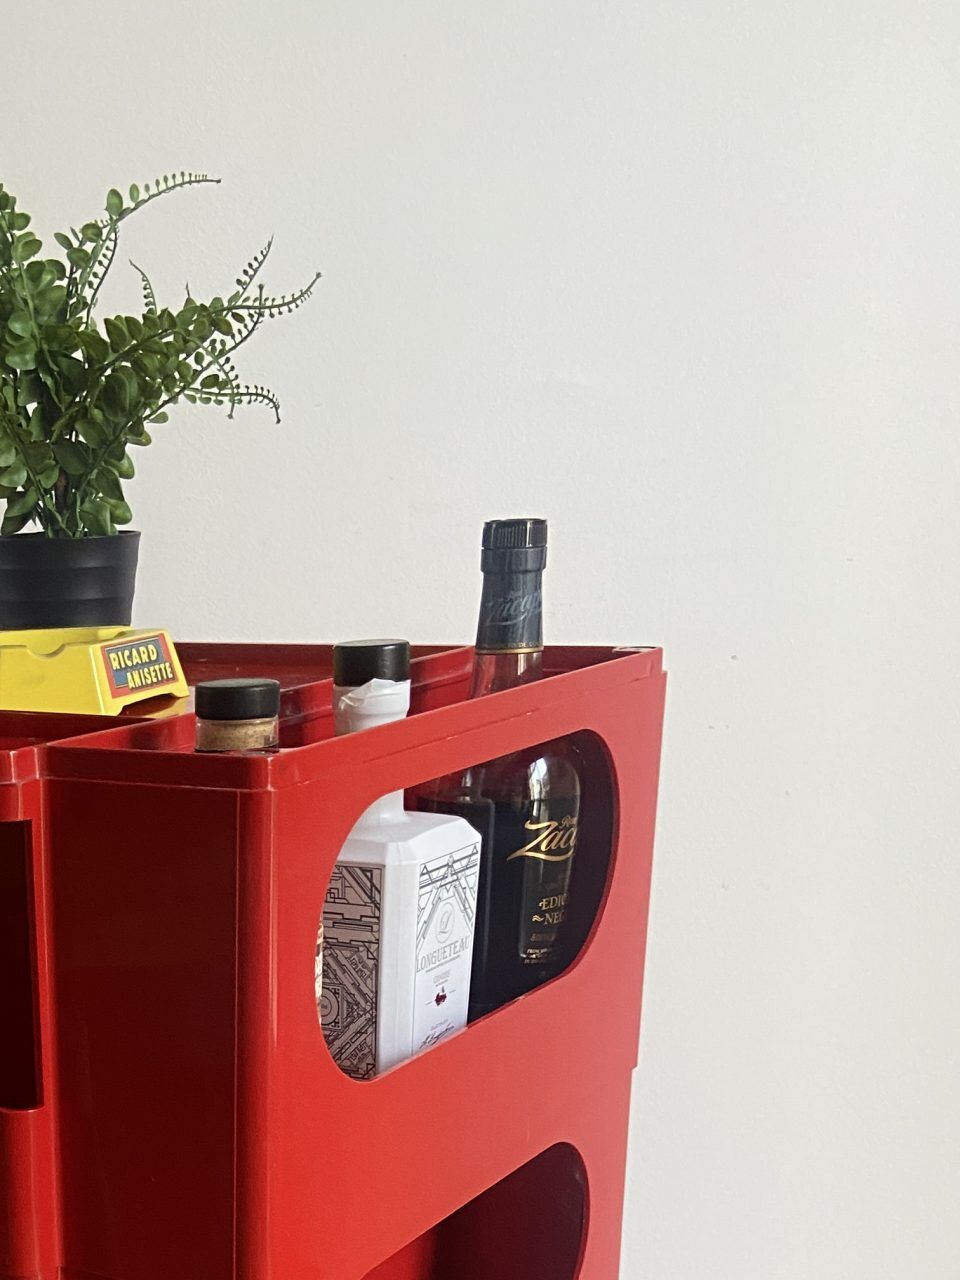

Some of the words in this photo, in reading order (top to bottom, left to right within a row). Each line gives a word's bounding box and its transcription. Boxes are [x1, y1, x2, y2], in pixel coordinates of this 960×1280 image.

[109, 644, 158, 671] RICARD
[126, 662, 174, 690] ANISETTE
[416, 935, 470, 973] LONGUETEAU
